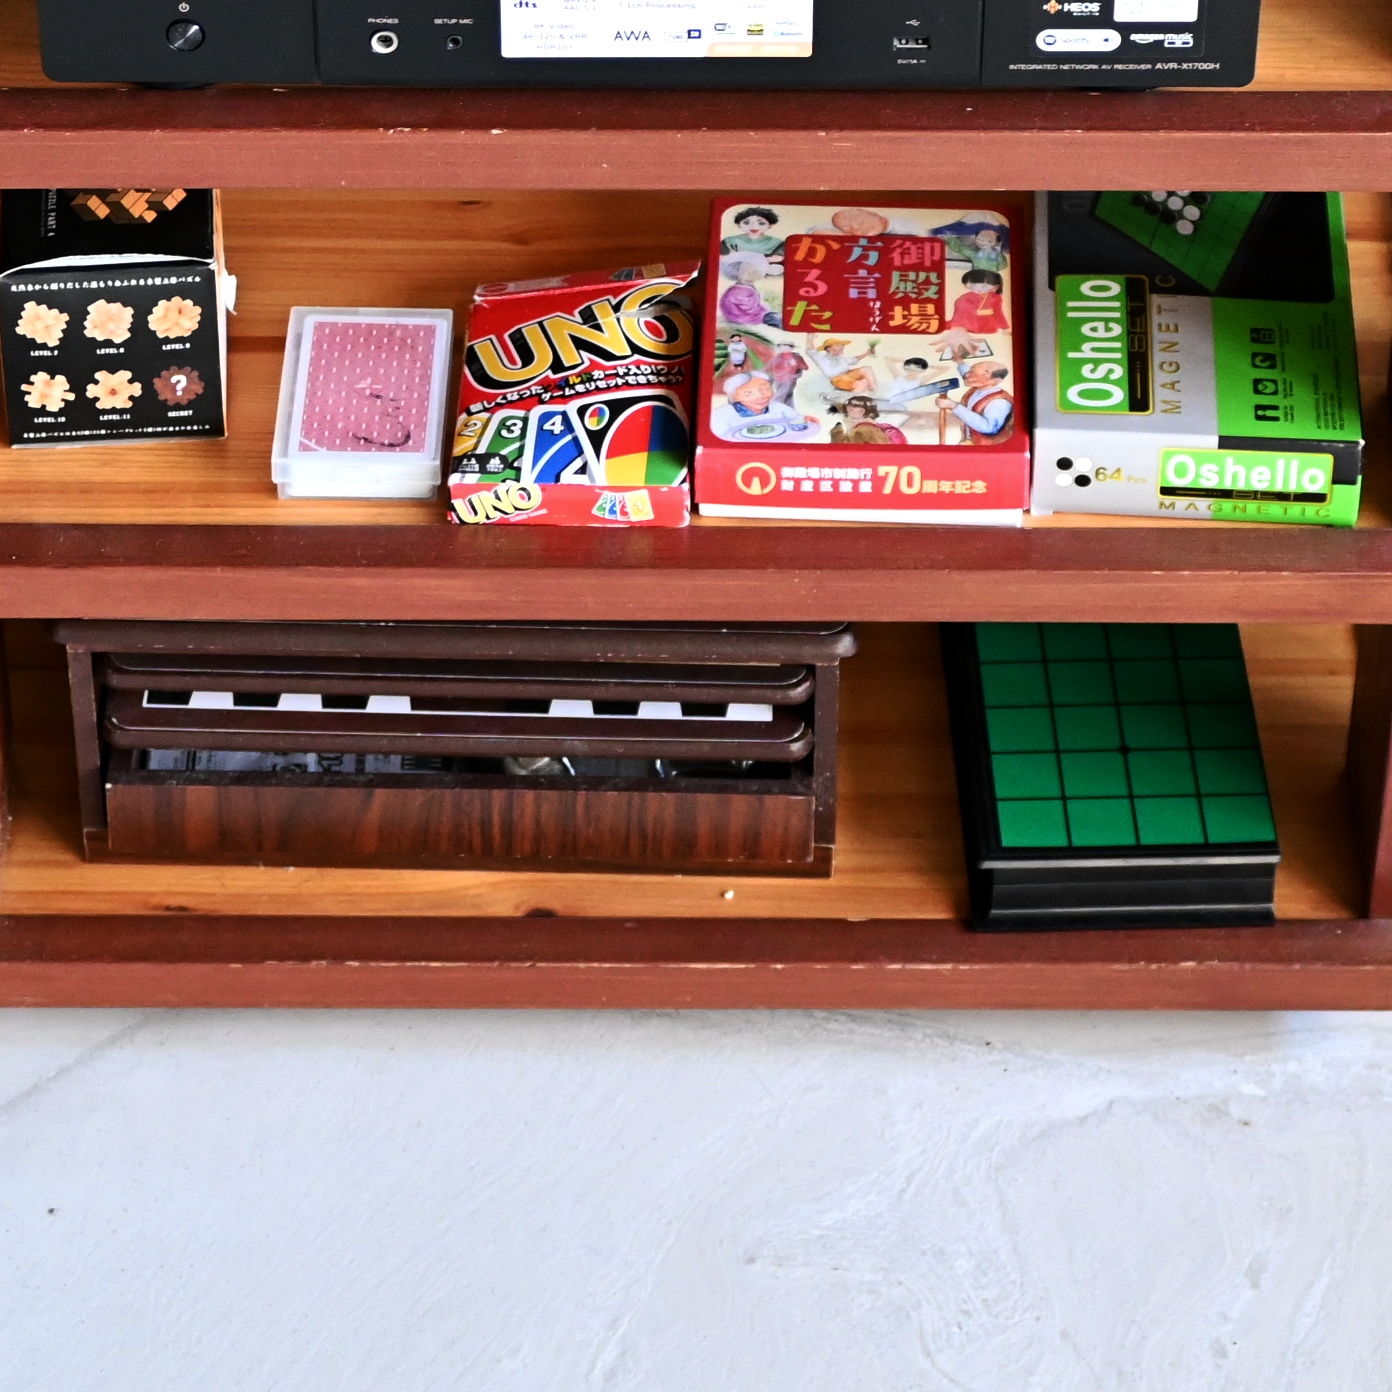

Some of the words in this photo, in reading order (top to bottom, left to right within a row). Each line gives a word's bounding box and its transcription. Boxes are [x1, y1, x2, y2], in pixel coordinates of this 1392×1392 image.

[513, 0, 538, 9] dts
[1063, 2, 1102, 12] HEOS
[47, 212, 57, 229] PART
[844, 237, 884, 299] 方言
[786, 237, 841, 331] かるた
[888, 239, 942, 333] 御殿場
[869, 301, 883, 332] ほうげん
[1128, 296, 1146, 353] SET
[468, 279, 694, 389] UNO
[1066, 279, 1125, 408] Oshello
[465, 419, 483, 437] 2
[500, 419, 524, 439] 3
[542, 415, 565, 435] 4
[877, 465, 988, 494] 70周年記念
[1094, 466, 1123, 483] 64
[1165, 454, 1326, 491] Oshello
[455, 483, 540, 524] UNO
[1158, 501, 1331, 519] MAGNETIC
[1232, 491, 1295, 501] SET
